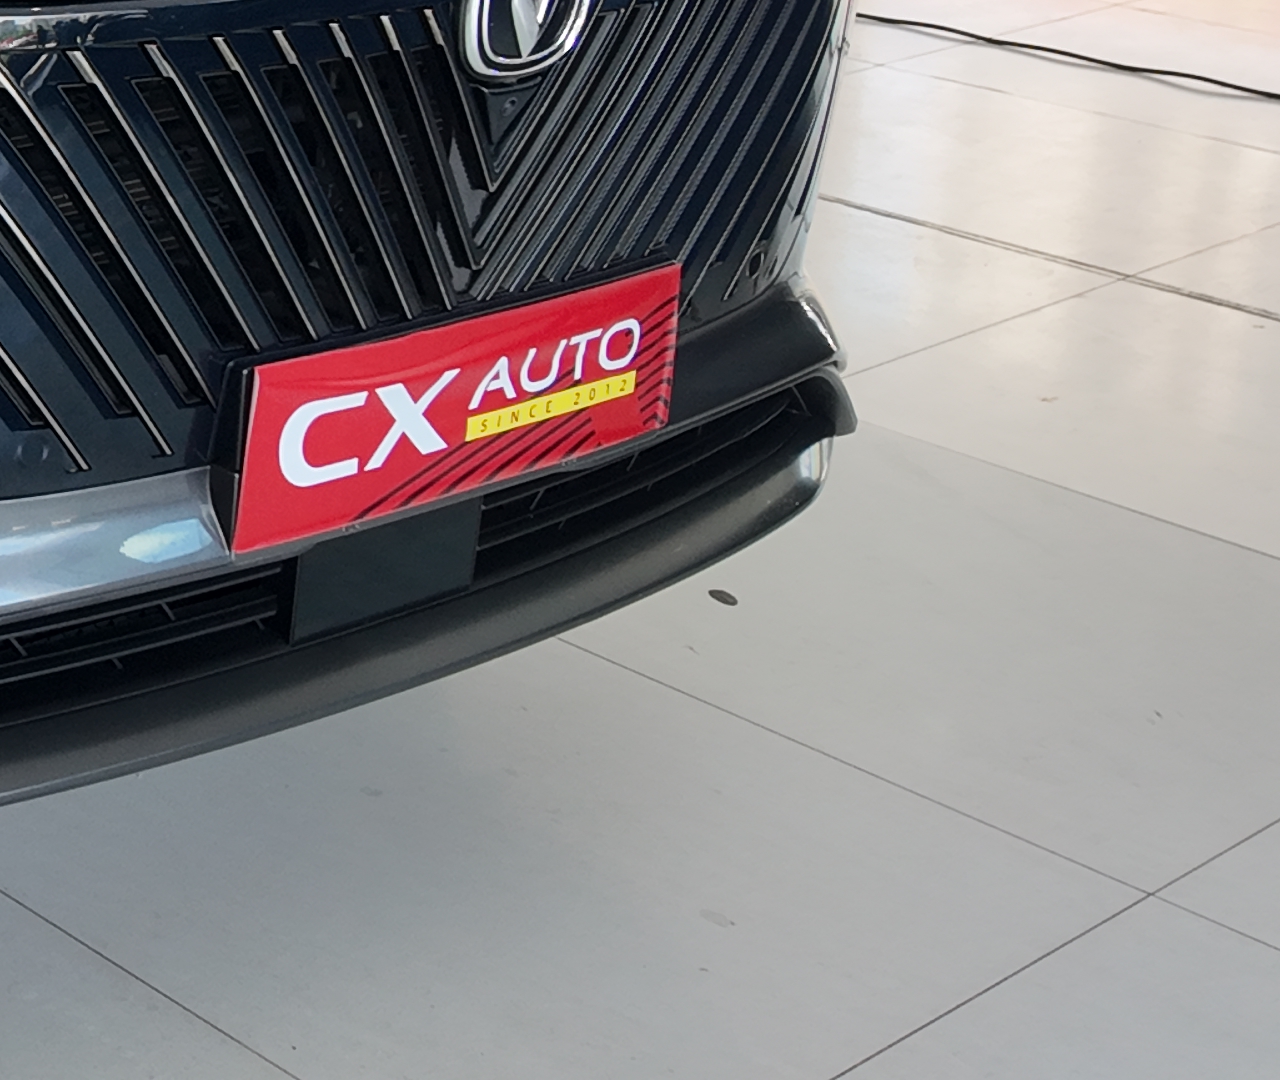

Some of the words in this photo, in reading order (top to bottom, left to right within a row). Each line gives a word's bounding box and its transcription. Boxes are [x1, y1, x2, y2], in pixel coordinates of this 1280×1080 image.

[278, 367, 460, 489] CX
[469, 318, 642, 410] AUTO
[479, 398, 555, 434] SINCE
[572, 377, 629, 408] 2012
